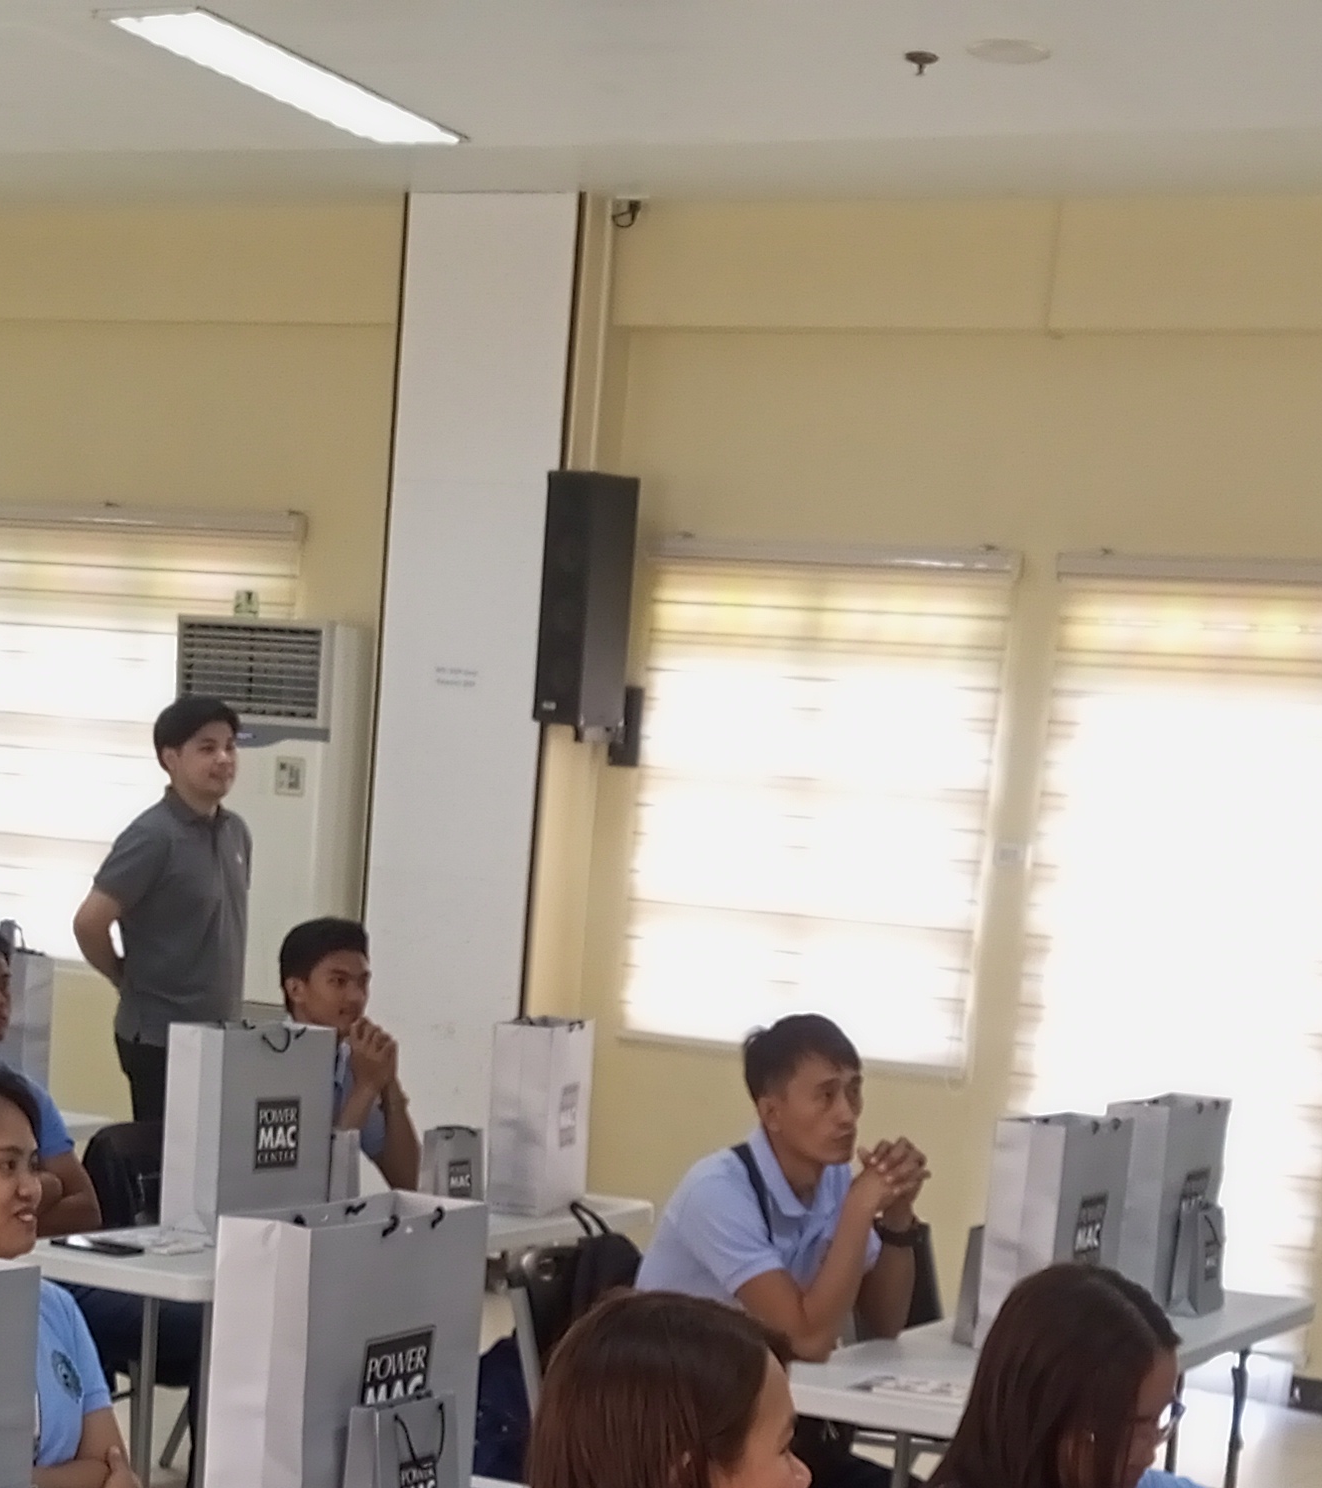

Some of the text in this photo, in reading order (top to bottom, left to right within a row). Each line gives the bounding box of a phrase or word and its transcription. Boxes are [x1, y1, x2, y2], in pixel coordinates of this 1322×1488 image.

[259, 1106, 298, 1123] POWER
[258, 1126, 297, 1150] MAC
[257, 1151, 297, 1163] CENTER
[450, 1174, 471, 1188] MAC
[367, 1346, 427, 1382] POWER
